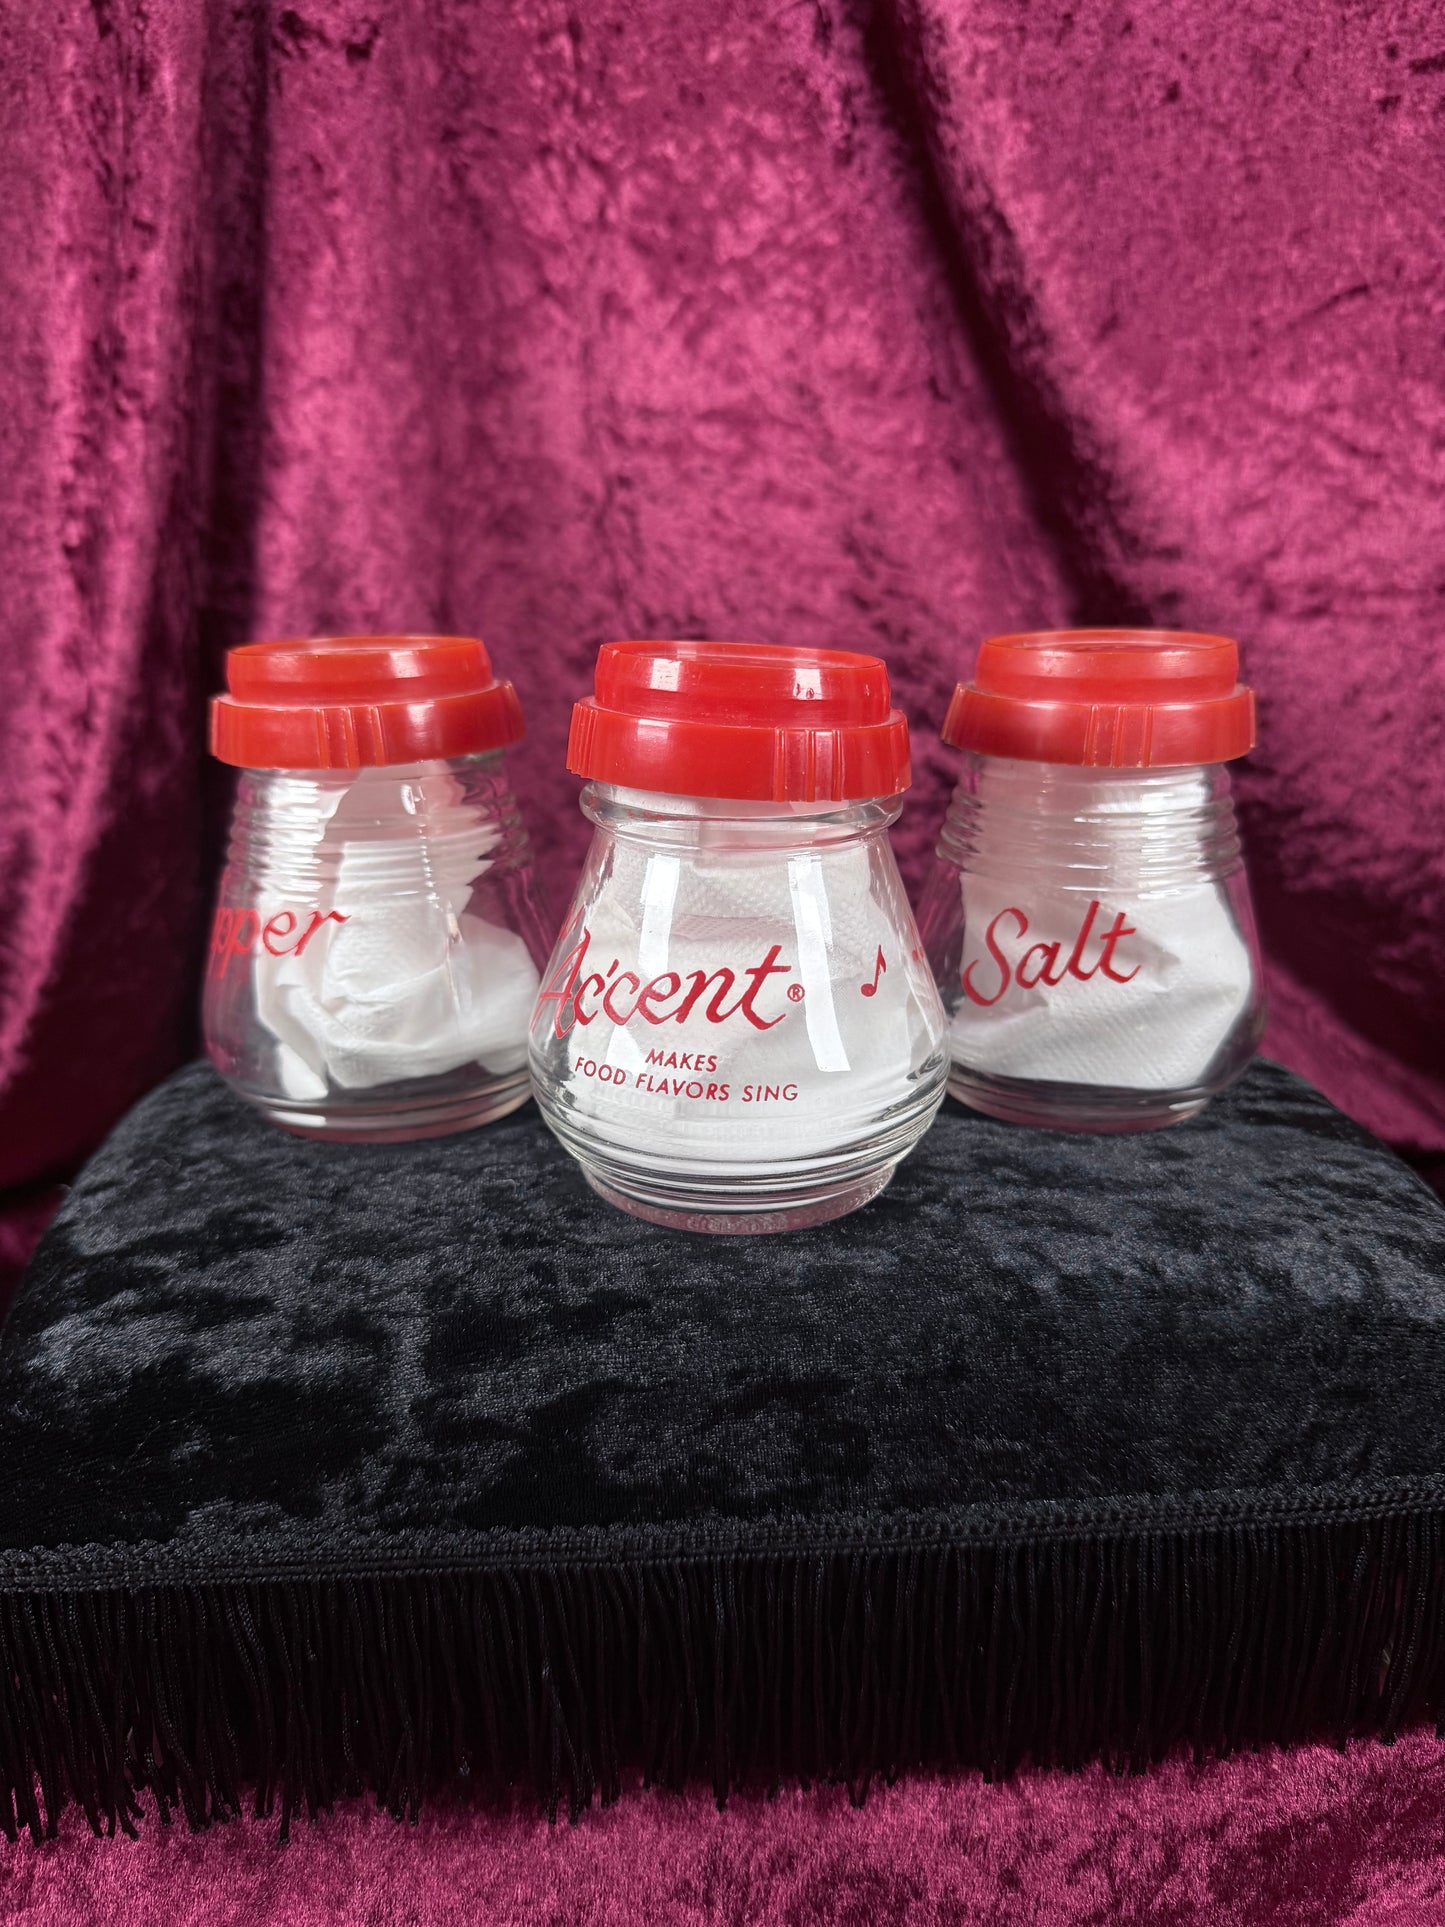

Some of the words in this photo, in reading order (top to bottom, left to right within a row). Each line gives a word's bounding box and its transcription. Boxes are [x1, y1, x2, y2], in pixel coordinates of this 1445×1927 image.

[962, 900, 1142, 1007] Salt
[574, 1056, 627, 1086] FOOD
[635, 1073, 731, 1102] FLAVORS
[741, 1083, 799, 1103] SING
[644, 1048, 719, 1073] MAKES
